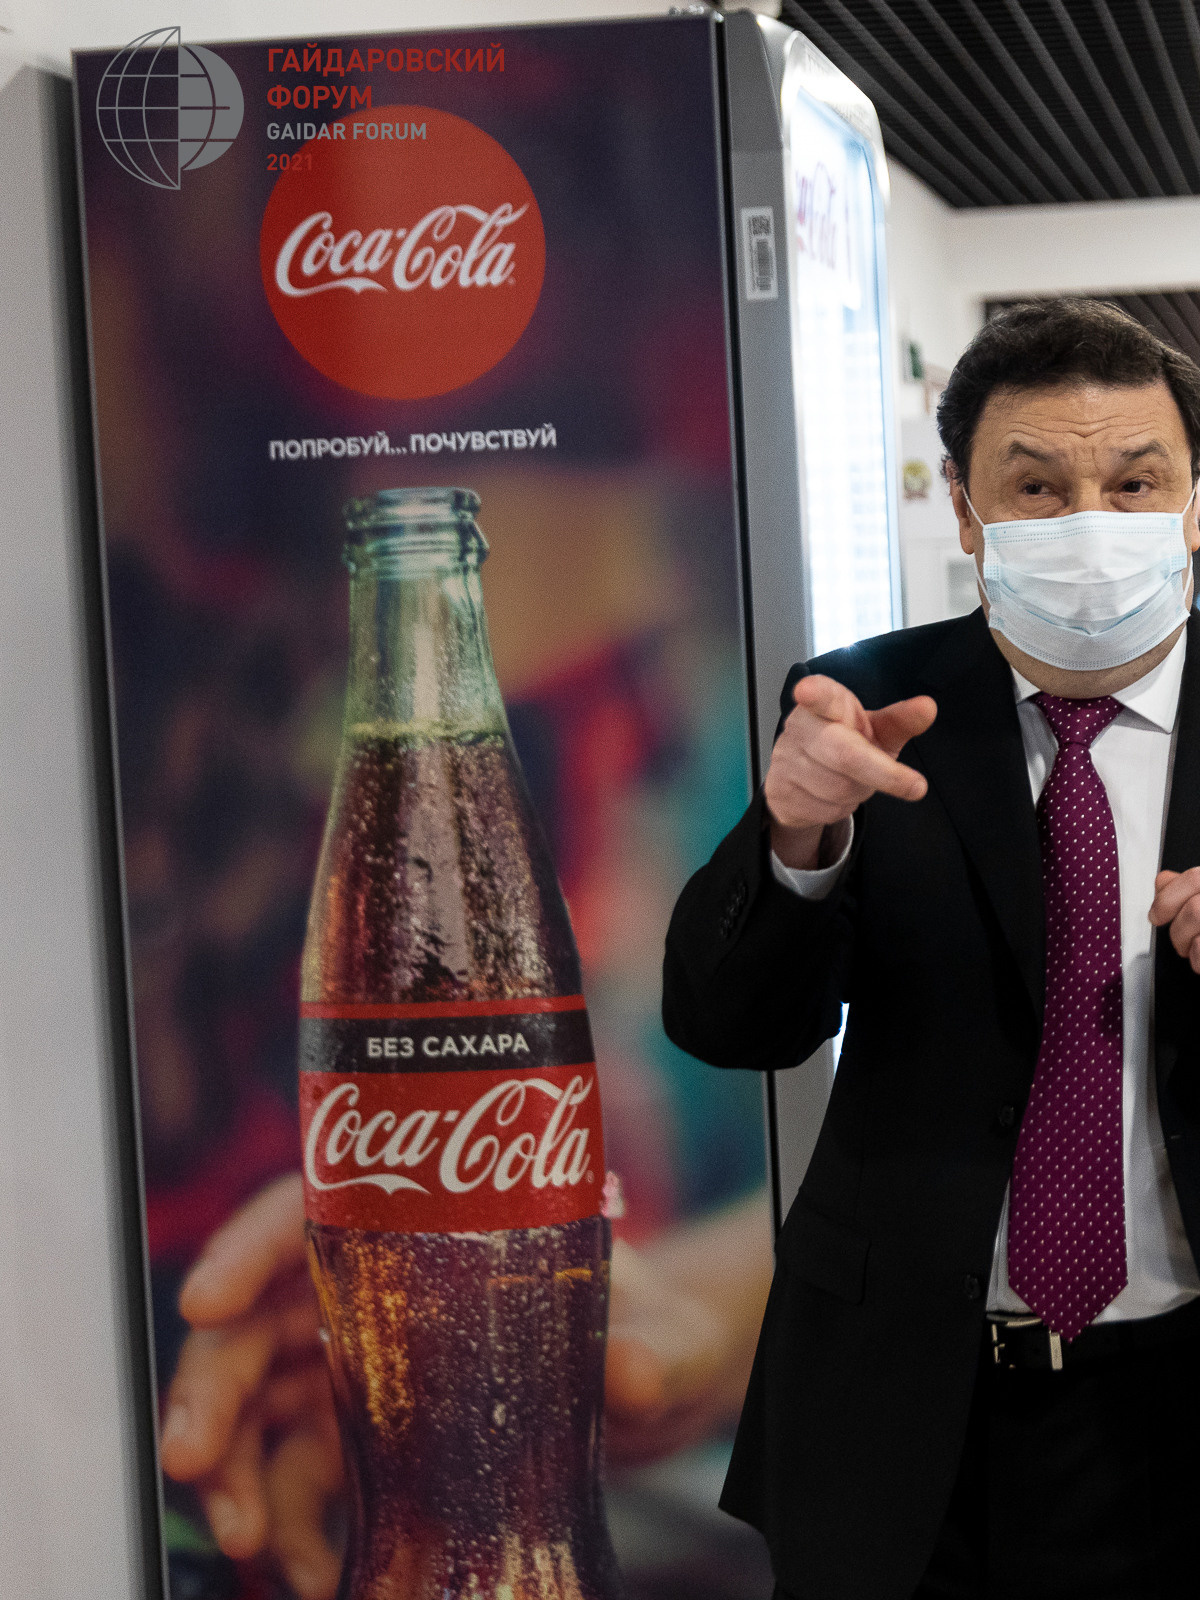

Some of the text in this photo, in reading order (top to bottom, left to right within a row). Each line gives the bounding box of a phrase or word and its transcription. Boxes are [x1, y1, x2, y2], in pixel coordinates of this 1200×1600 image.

[275, 202, 529, 297] Coca-Cola
[410, 423, 557, 454] ПОЧУВСТВУЙ
[366, 1032, 530, 1058] БЕЗ САХАРА
[305, 1074, 594, 1194] Coca-Cola
